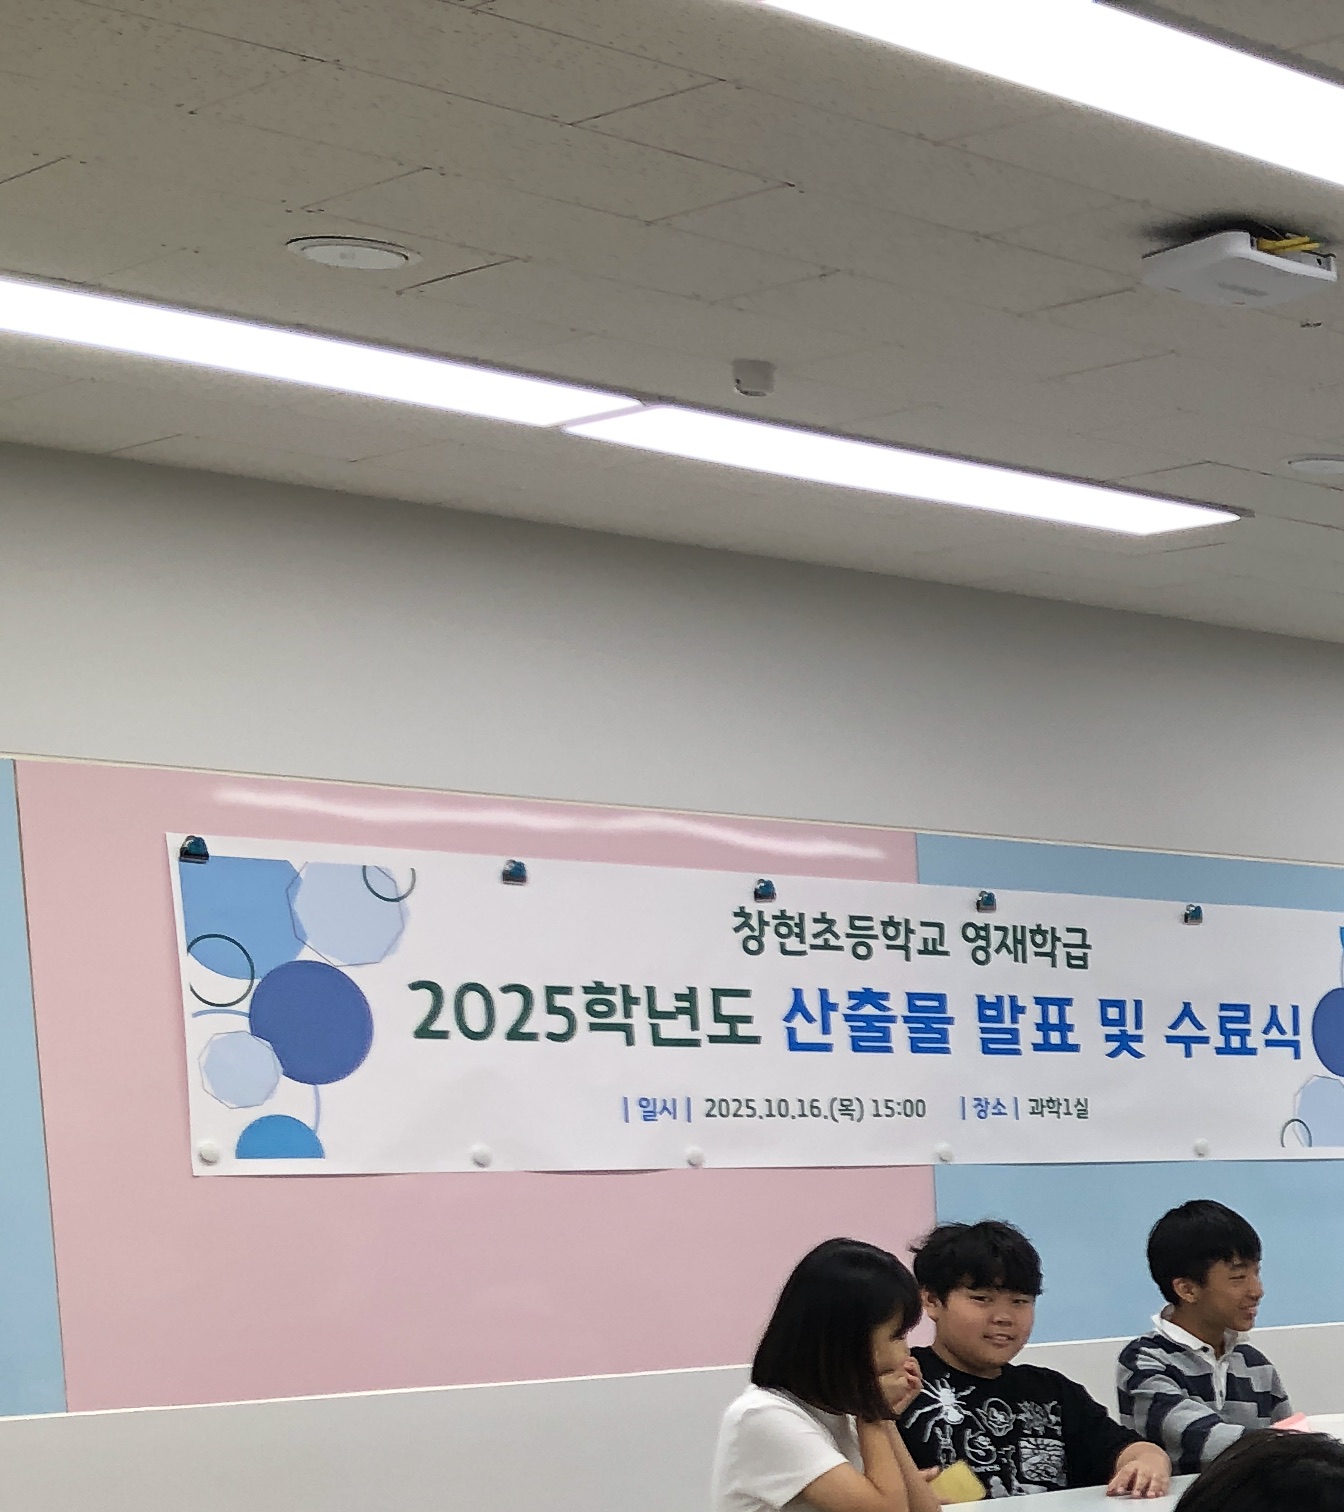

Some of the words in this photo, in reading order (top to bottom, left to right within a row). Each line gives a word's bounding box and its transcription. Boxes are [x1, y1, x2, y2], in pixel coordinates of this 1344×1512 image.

[731, 904, 952, 960] 창현초등학교
[960, 922, 1094, 971] 영재학급
[408, 979, 764, 1050] 2025학년도
[782, 986, 957, 1057] 산출물
[974, 993, 1082, 1058] 발표
[1097, 998, 1147, 1061] 및
[1164, 1000, 1304, 1063] 수료식
[638, 1096, 679, 1123] 일시
[704, 1096, 866, 1124] 2025.10.16.(목)
[871, 1098, 928, 1119] 15:00
[972, 1098, 1009, 1120] 장소
[1028, 1097, 1090, 1121] 과학1실
